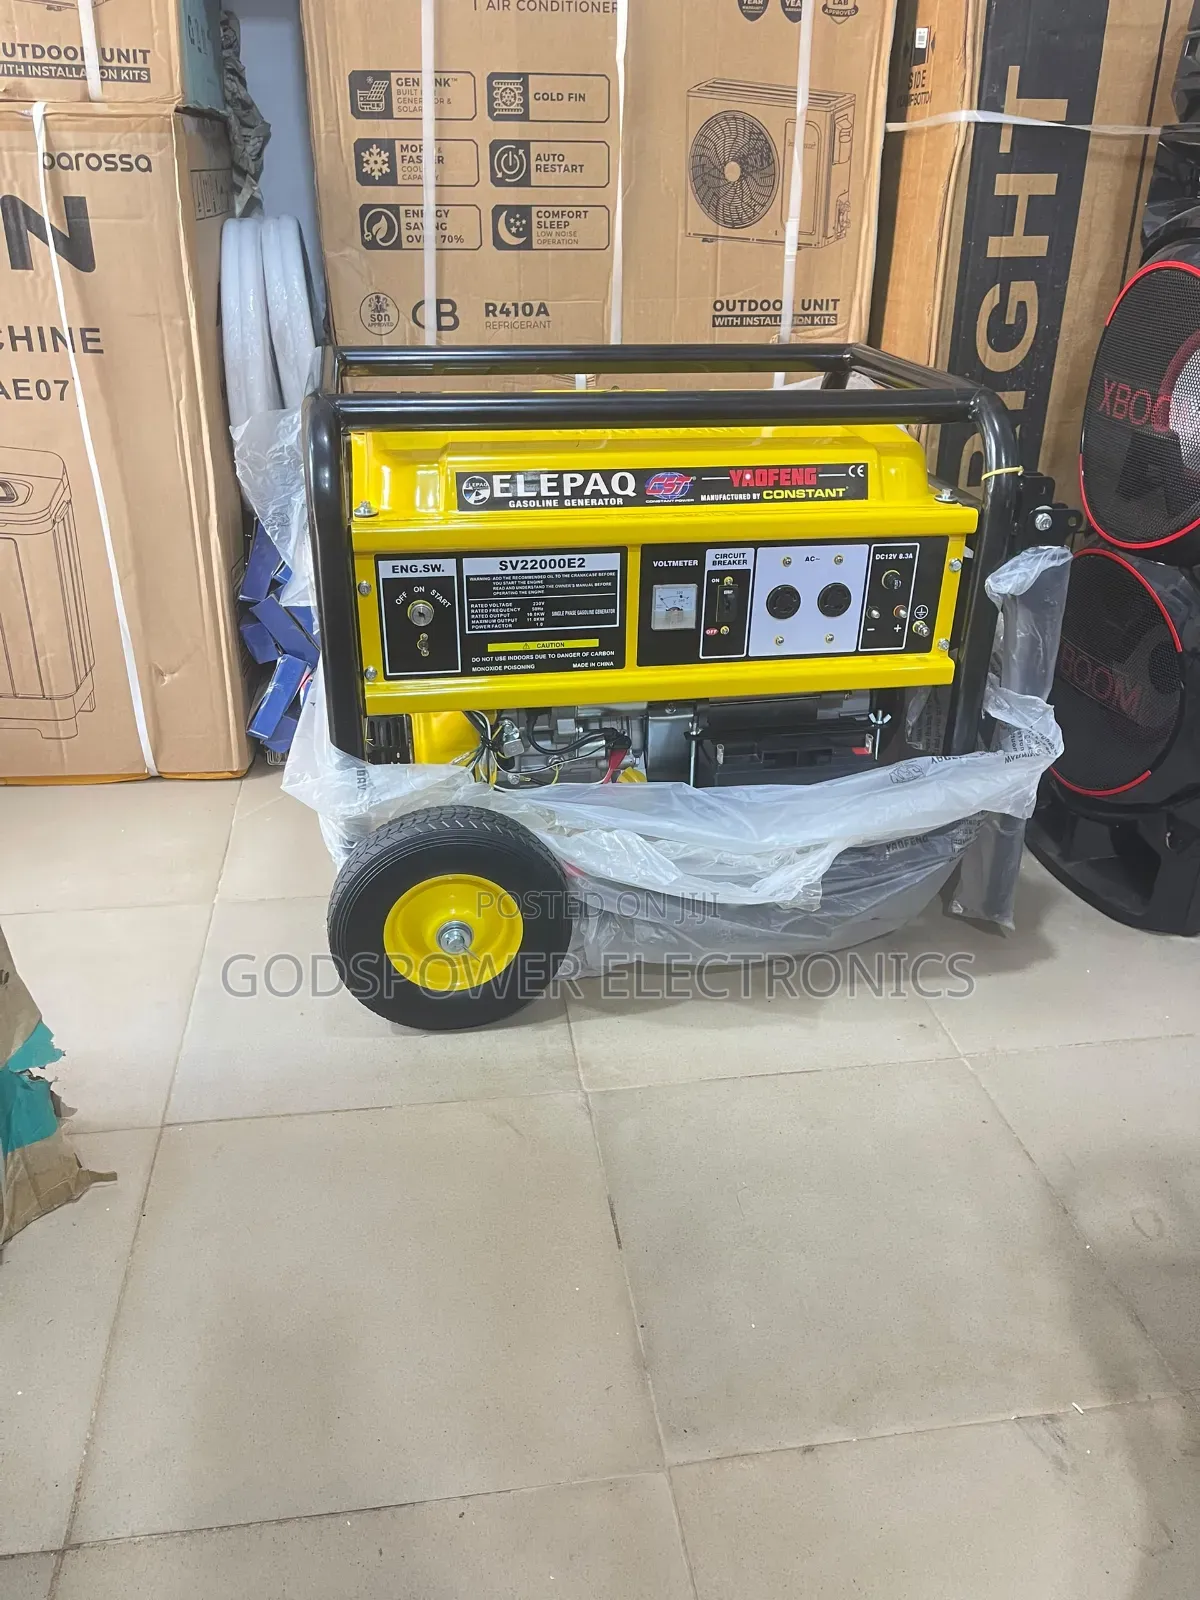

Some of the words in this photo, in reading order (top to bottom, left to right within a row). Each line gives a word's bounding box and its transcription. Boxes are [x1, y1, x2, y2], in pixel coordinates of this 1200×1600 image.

[486, 0, 511, 11] AIR
[824, 8, 856, 16] APPROVED
[101, 47, 150, 64] UNIT
[0, 64, 25, 75] ITH
[28, 65, 118, 80] INSTALLAON
[120, 69, 149, 81] KITS
[396, 88, 418, 96] BUILT
[533, 92, 564, 102] GOLD
[567, 93, 586, 103] FIN
[400, 144, 430, 153] MOR
[401, 155, 445, 165] FASR
[535, 154, 565, 163] AUTO
[535, 164, 585, 174] RESTART
[404, 209, 450, 218] ENGY
[536, 210, 589, 219] COMFORT
[405, 222, 448, 231] SAVNG
[536, 220, 570, 229] SLEEP
[0, 194, 96, 273] N
[536, 230, 553, 238] LOW
[555, 230, 578, 238] NOISE
[441, 235, 465, 243] 70%
[536, 238, 579, 246] OPERATION
[484, 302, 550, 318] R410A
[712, 299, 783, 312] OUTDOO
[801, 298, 840, 311] UNIT
[484, 320, 552, 331] REFRIGERANT
[714, 316, 741, 326] WITH
[743, 316, 811, 326] INSTALLION
[813, 315, 837, 325] KITS
[0, 325, 104, 354] HINE
[848, 465, 865, 478] CE
[729, 467, 817, 487] YAOFENG
[492, 472, 637, 497] ELEPAQ
[700, 493, 751, 502] MANUFACTURED
[752, 492, 761, 500] BY
[763, 488, 846, 500] CONSTANT
[508, 499, 559, 508] GASOLINE
[564, 498, 624, 507] GENERATOR
[714, 552, 747, 560] CIRCUIT
[498, 557, 586, 571] SV22000E2
[652, 559, 699, 567] VOLTMETER
[711, 559, 748, 567] BREAKER
[391, 564, 445, 574] ENG.SW.
[395, 591, 408, 605] OFF
[430, 589, 452, 608] START
[536, 641, 565, 649] CAUTION
[503, 663, 535, 671] POISONING
